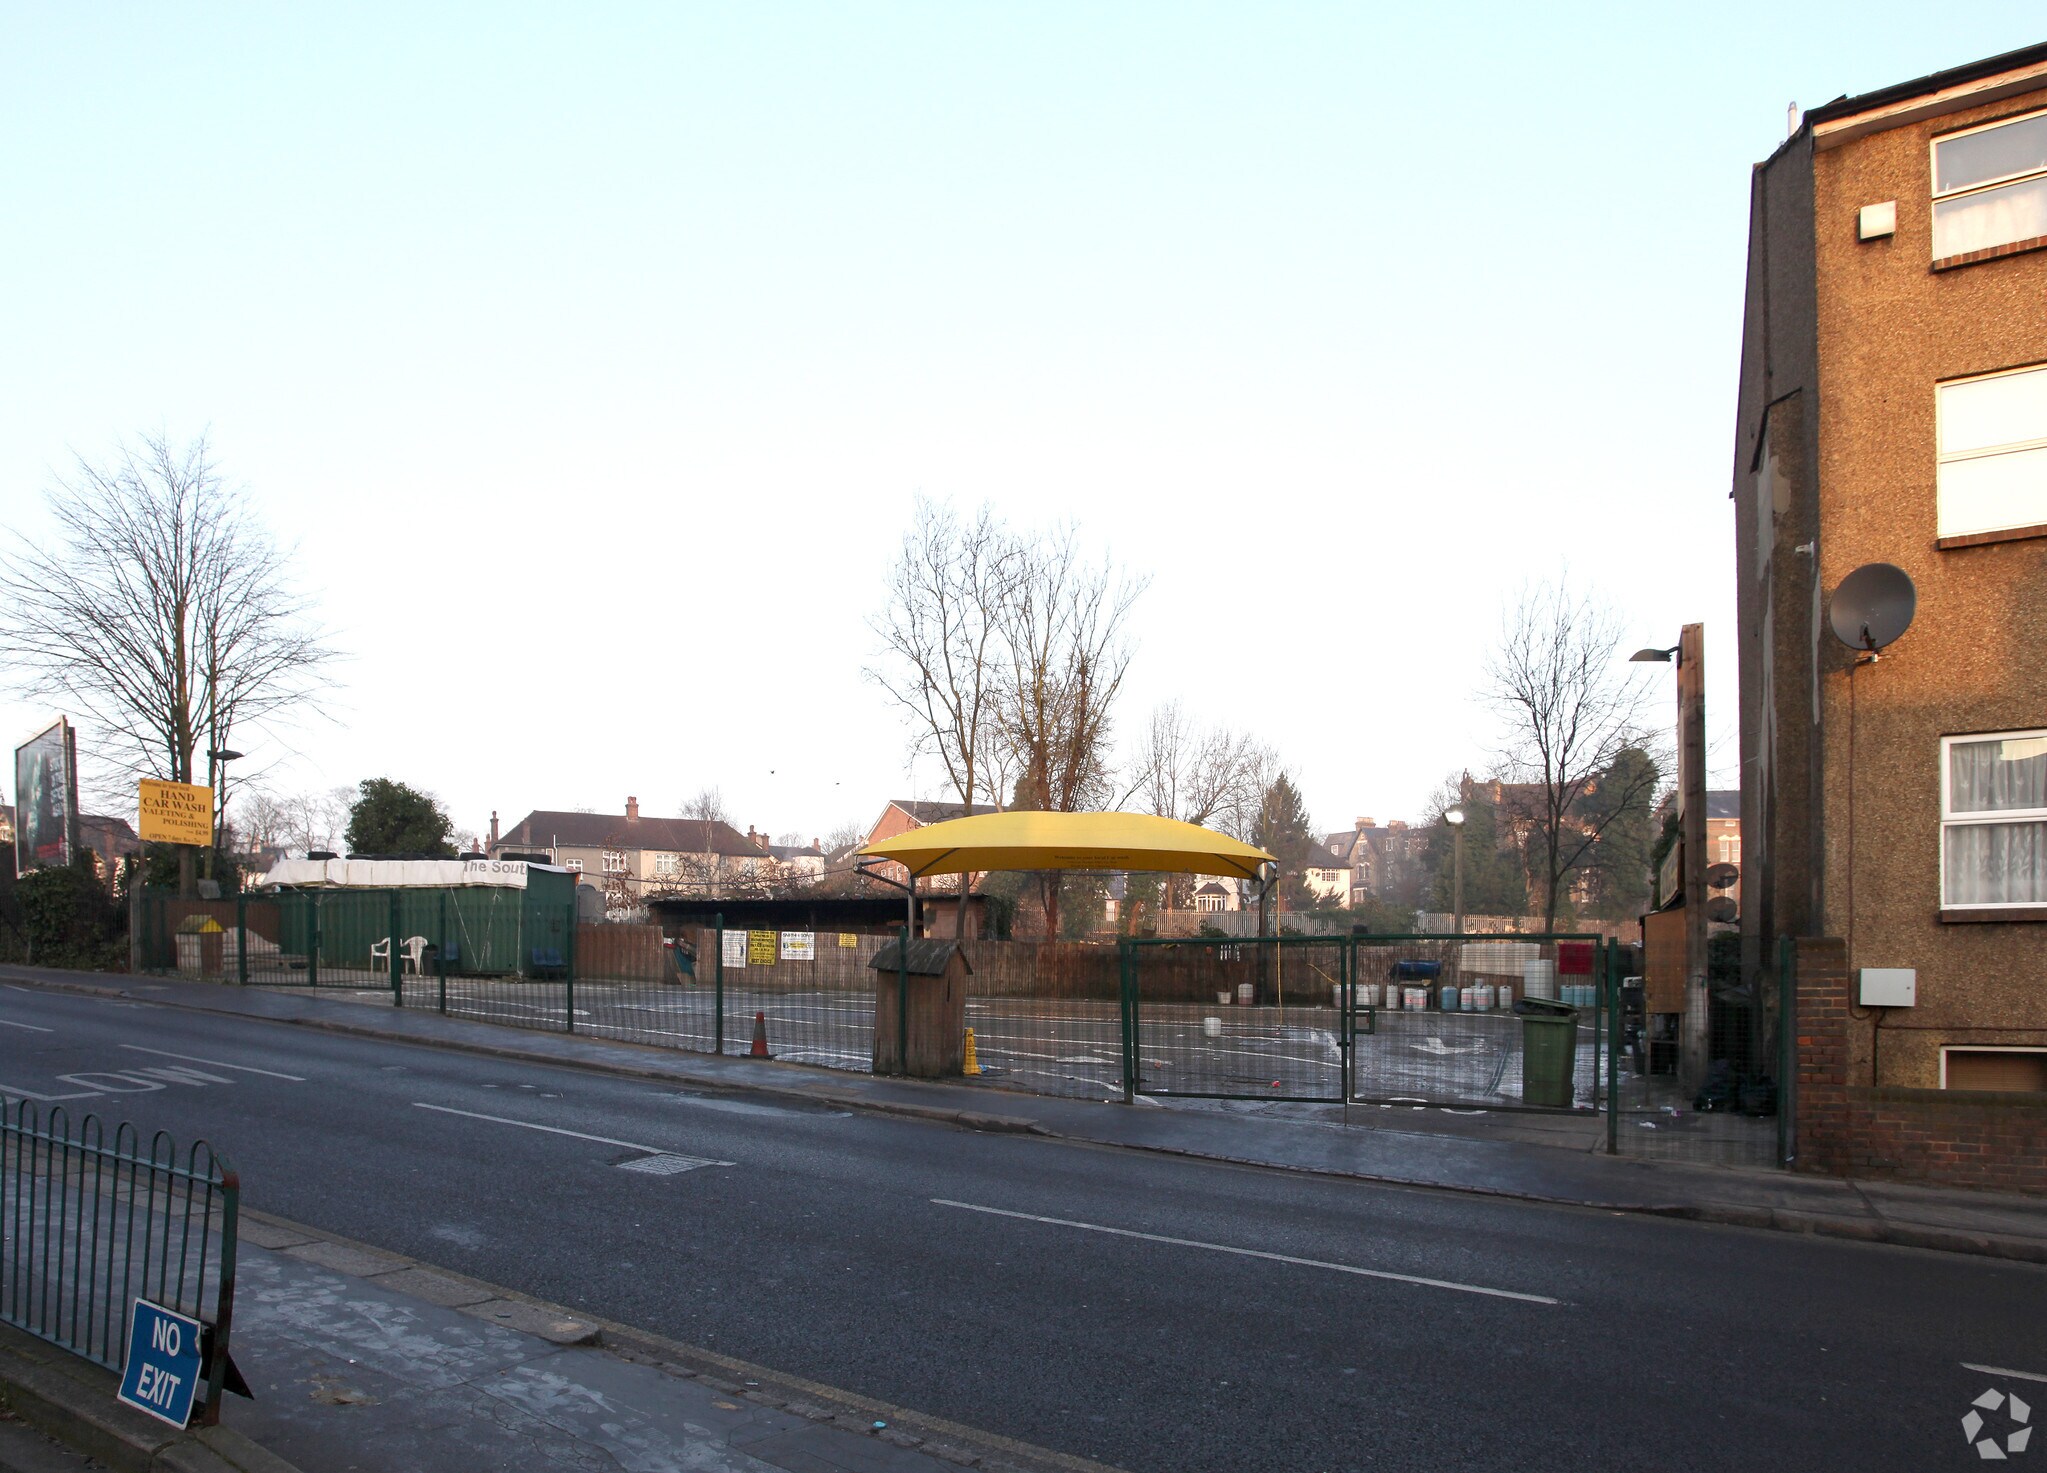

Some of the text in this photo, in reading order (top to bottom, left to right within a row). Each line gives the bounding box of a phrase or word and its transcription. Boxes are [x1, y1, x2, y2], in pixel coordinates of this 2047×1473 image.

[160, 790, 195, 801] HAND
[143, 797, 206, 813] CAR WASH
[143, 807, 187, 819] VALETING
[163, 818, 208, 829] POLISHING
[463, 861, 487, 872] The
[152, 1316, 180, 1356] NO
[135, 1362, 181, 1409] EXIT
